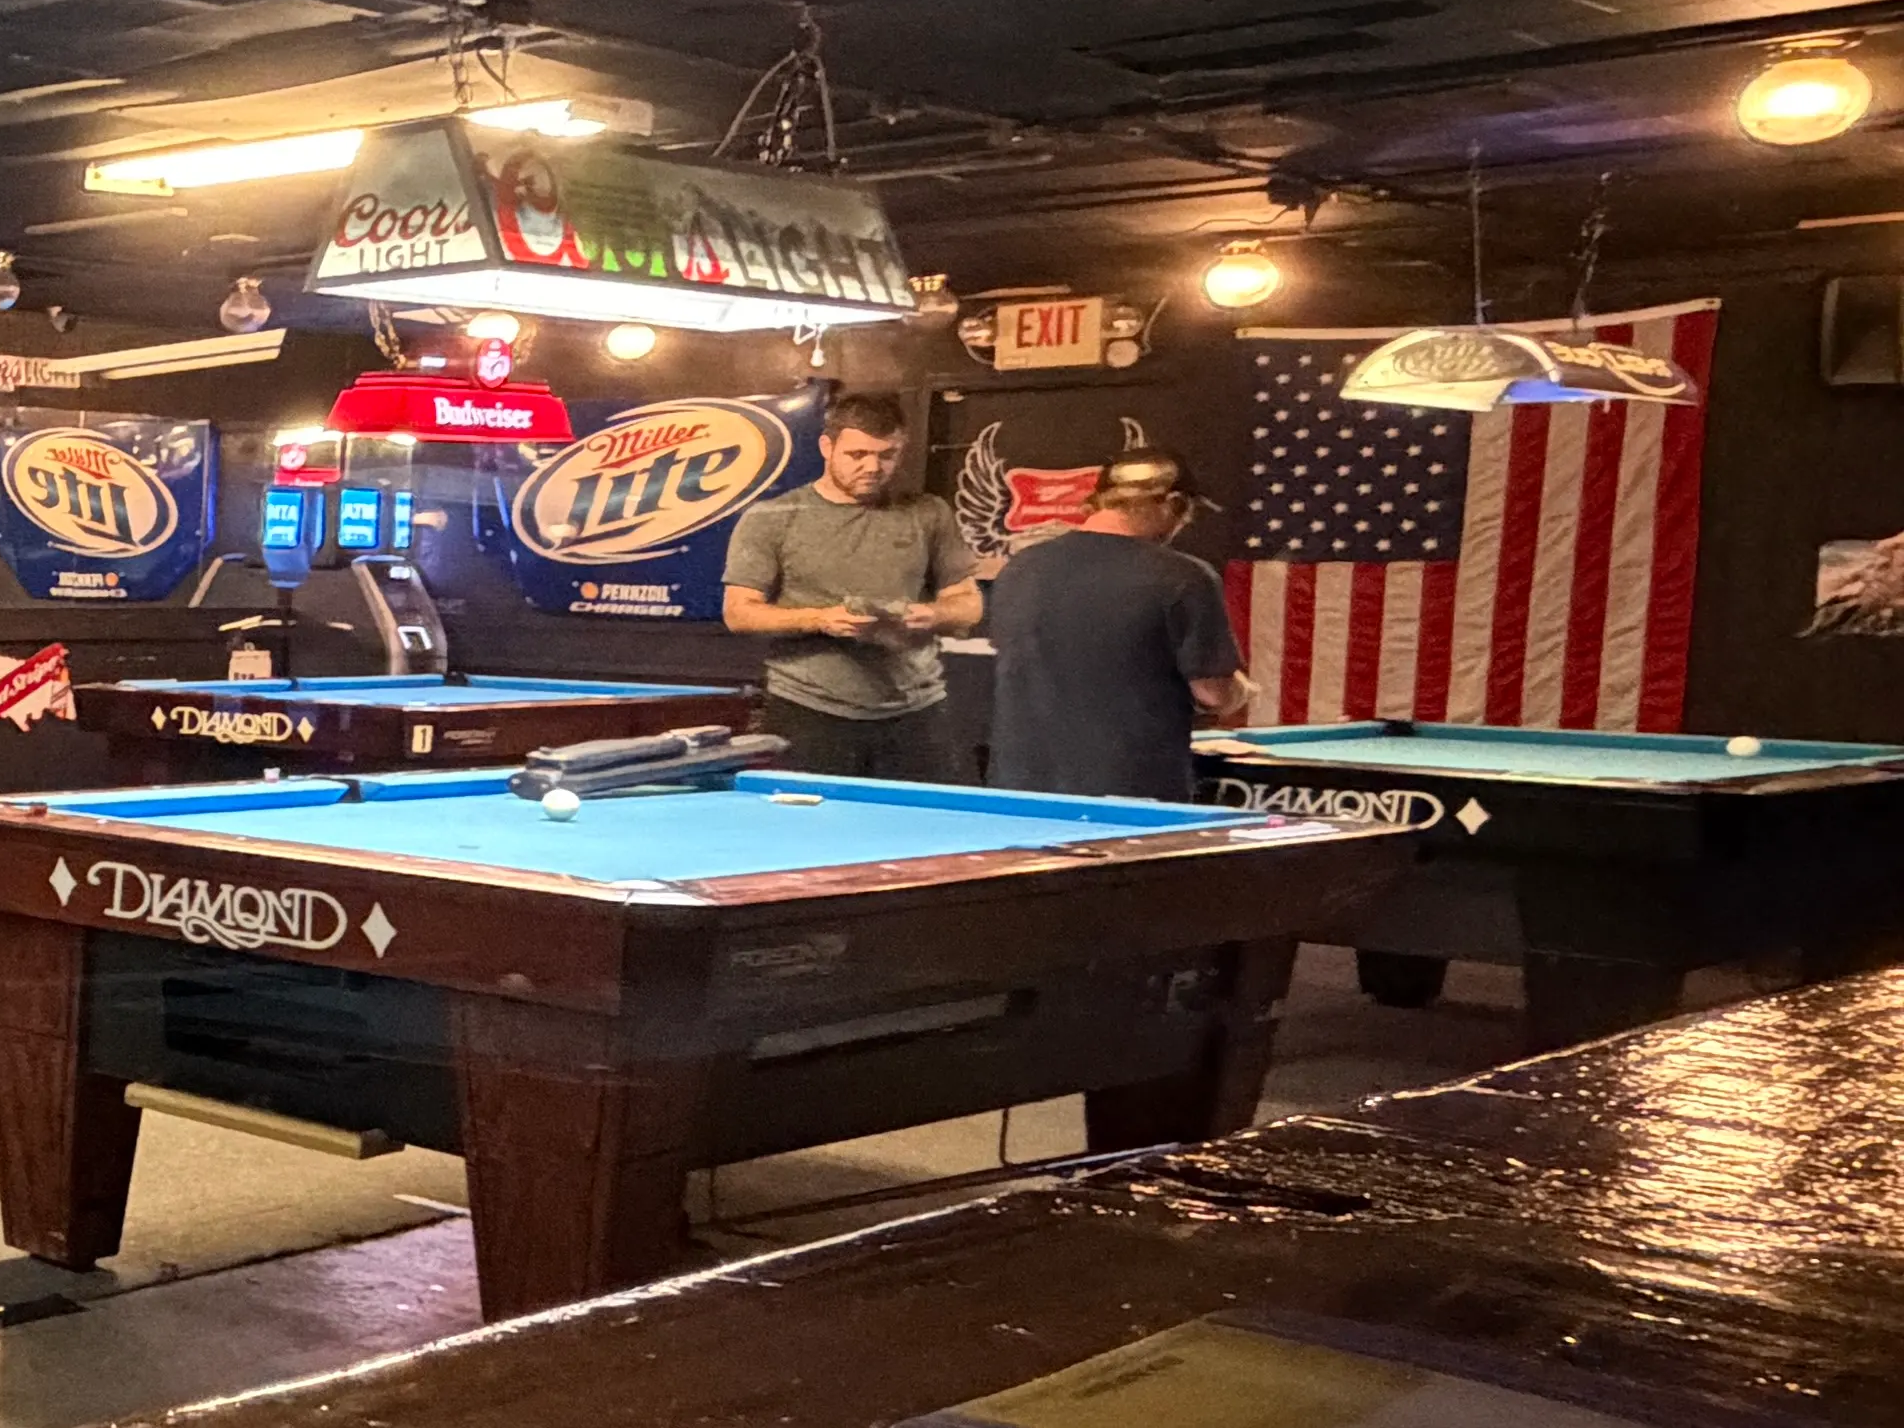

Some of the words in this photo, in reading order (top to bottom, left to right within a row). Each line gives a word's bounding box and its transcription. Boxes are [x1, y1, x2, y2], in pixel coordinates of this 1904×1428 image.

[335, 192, 473, 248] Coors
[358, 238, 451, 273] LIGHT
[1015, 304, 1087, 349] EXIT
[433, 396, 534, 429] Budweiser
[587, 423, 710, 466] Miller
[551, 445, 742, 551] Lite
[601, 583, 671, 603] PENNZOIL
[169, 705, 294, 745] DIAMOND
[1215, 777, 1445, 830] DIAMOND
[87, 860, 348, 951] DIAMOND
